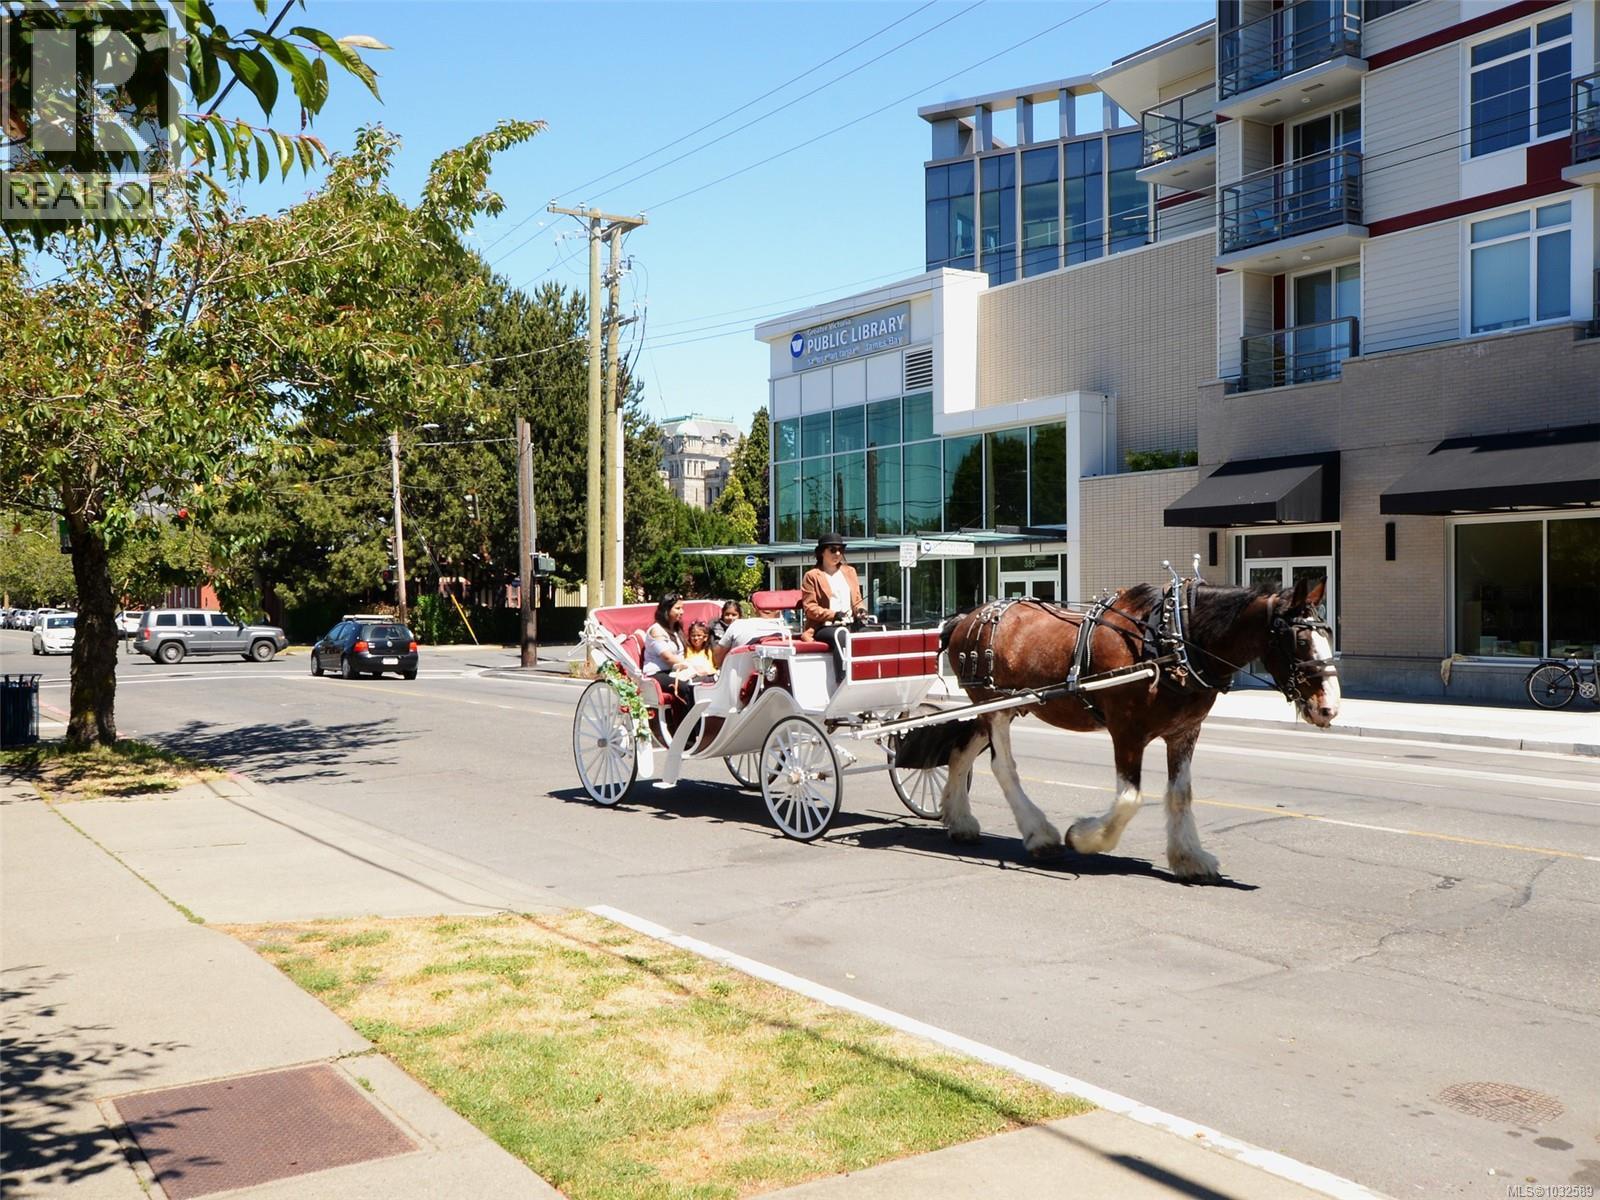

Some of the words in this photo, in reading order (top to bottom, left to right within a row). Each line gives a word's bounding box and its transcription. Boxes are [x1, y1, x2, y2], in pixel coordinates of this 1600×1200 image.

[807, 329, 848, 354] PUBLIC
[851, 314, 905, 342] LIBRARY
[888, 336, 903, 346] Bay
